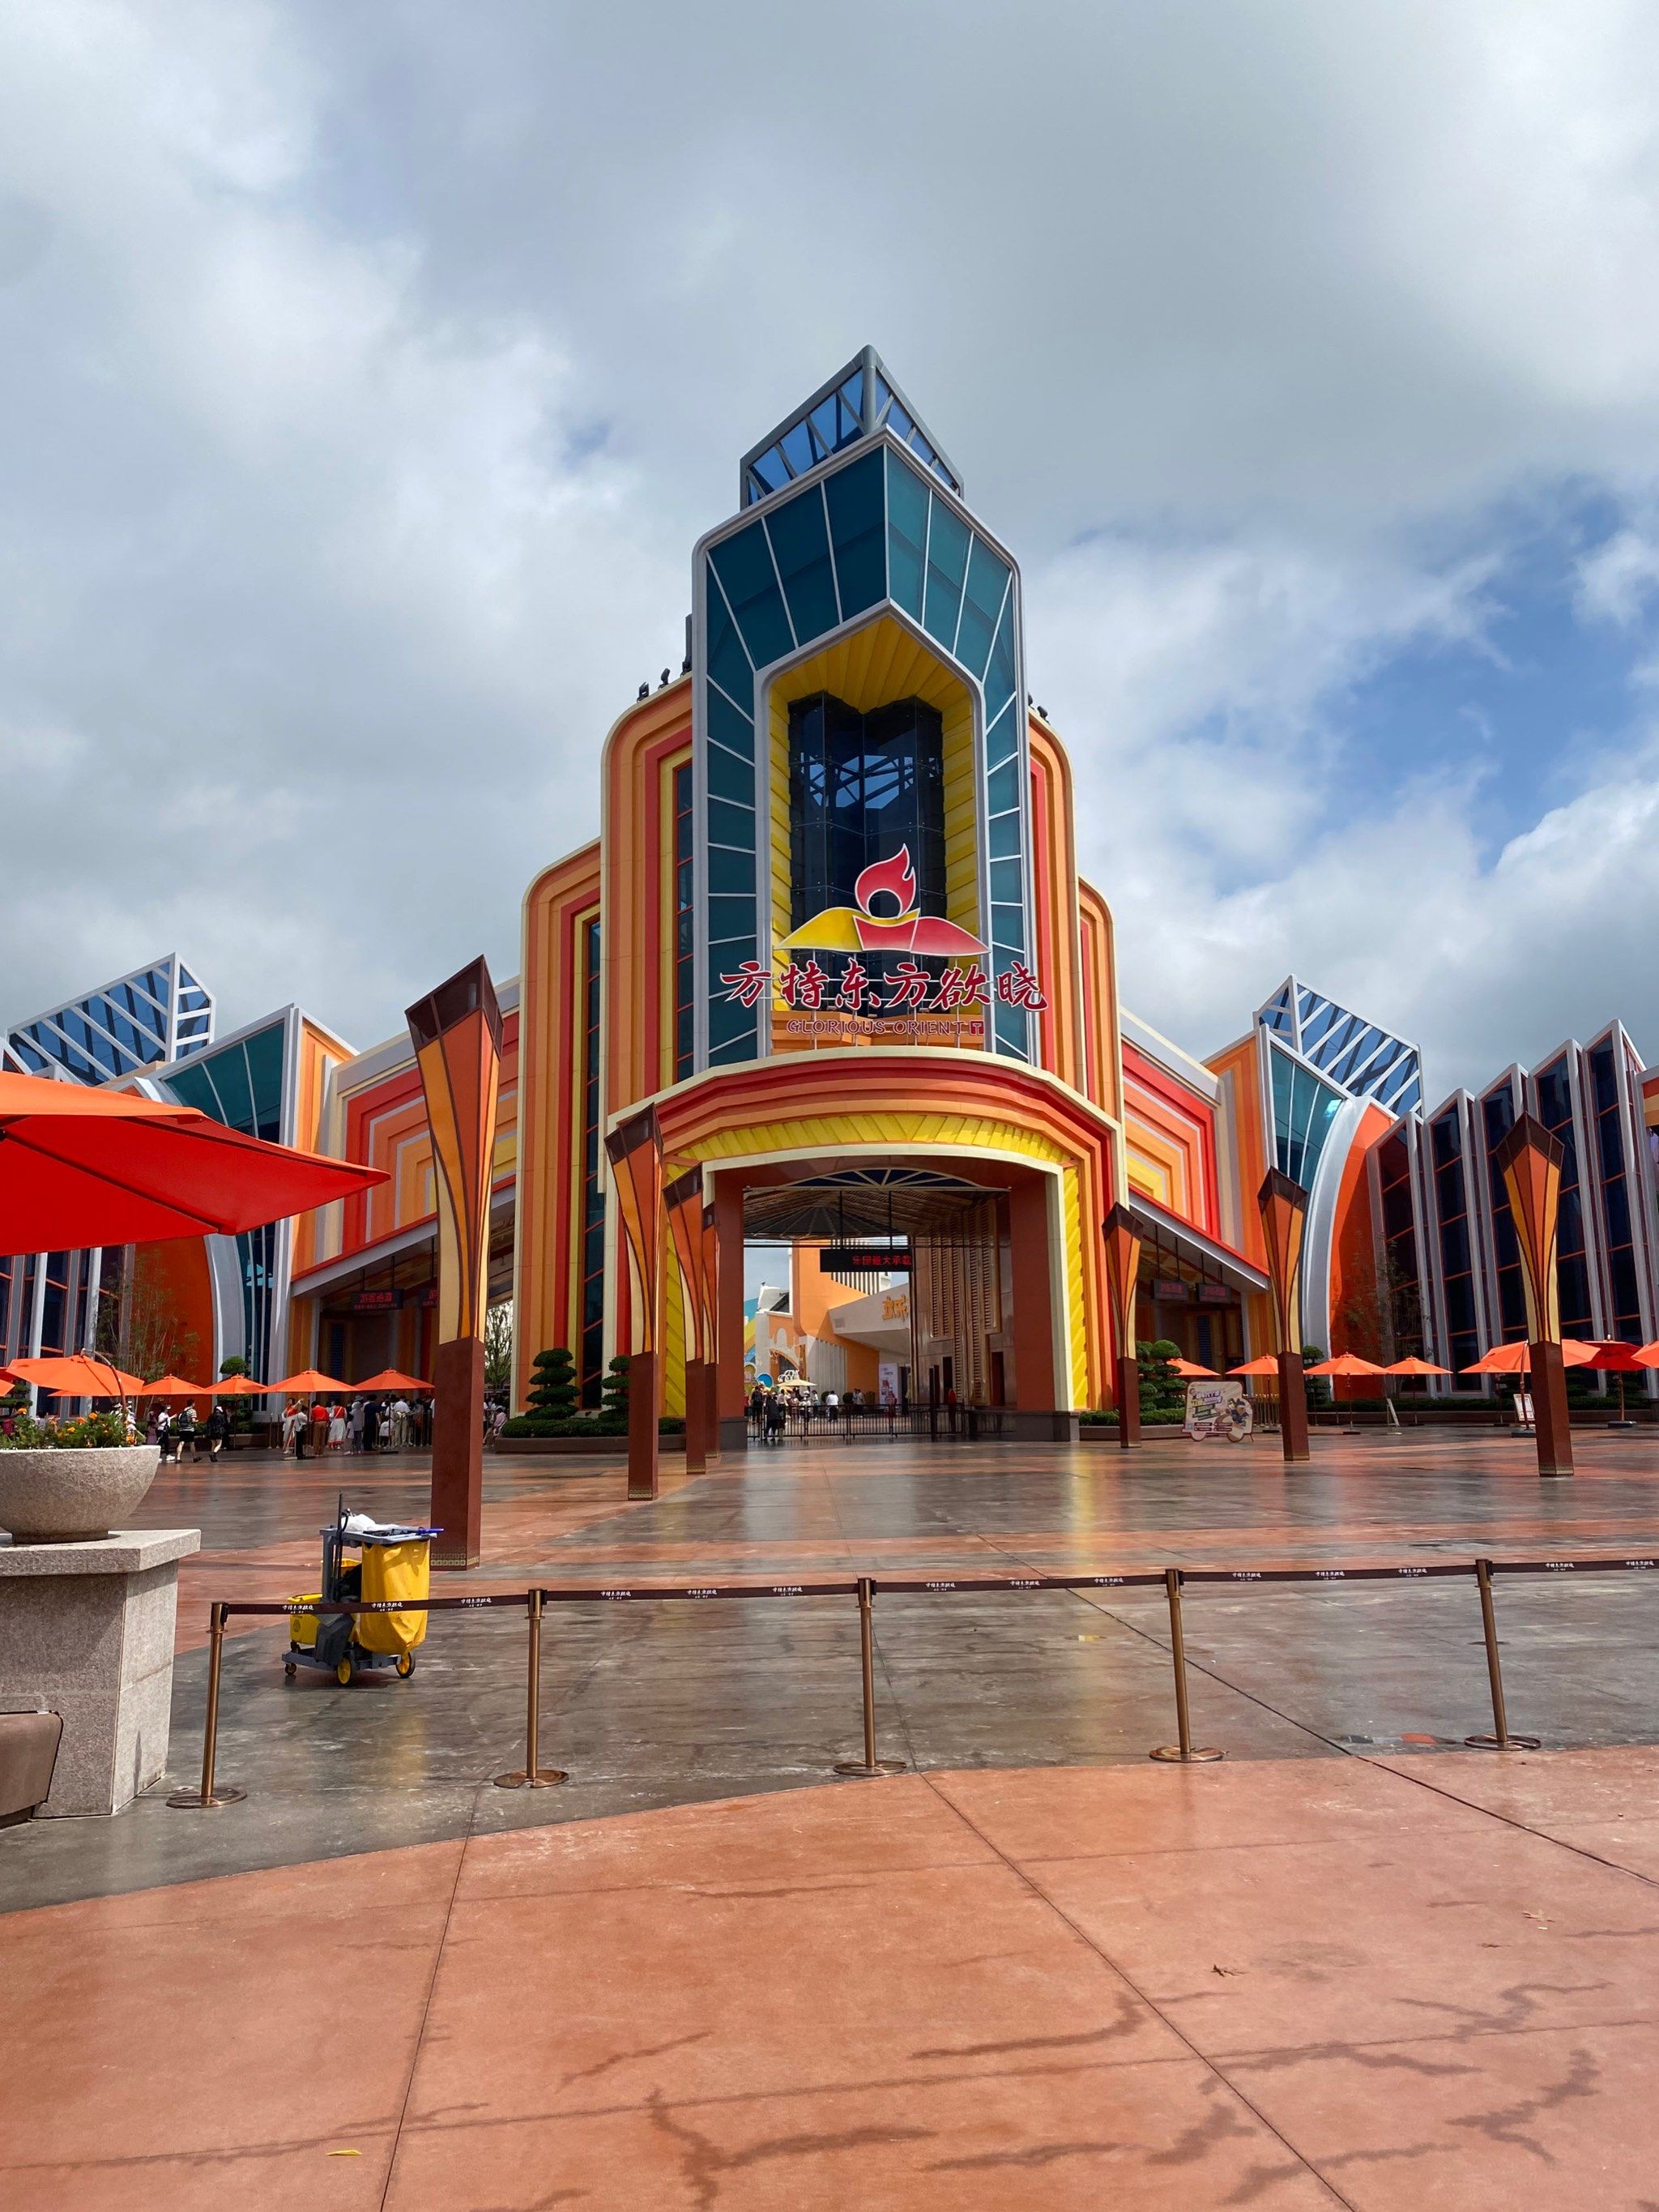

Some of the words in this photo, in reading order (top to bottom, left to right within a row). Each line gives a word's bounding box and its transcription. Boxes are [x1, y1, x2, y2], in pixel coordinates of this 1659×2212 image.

[719, 958, 1049, 1011] 方特东方欲晓
[786, 1018, 886, 1036] GLORIOUS
[893, 1019, 964, 1036] ORIENT
